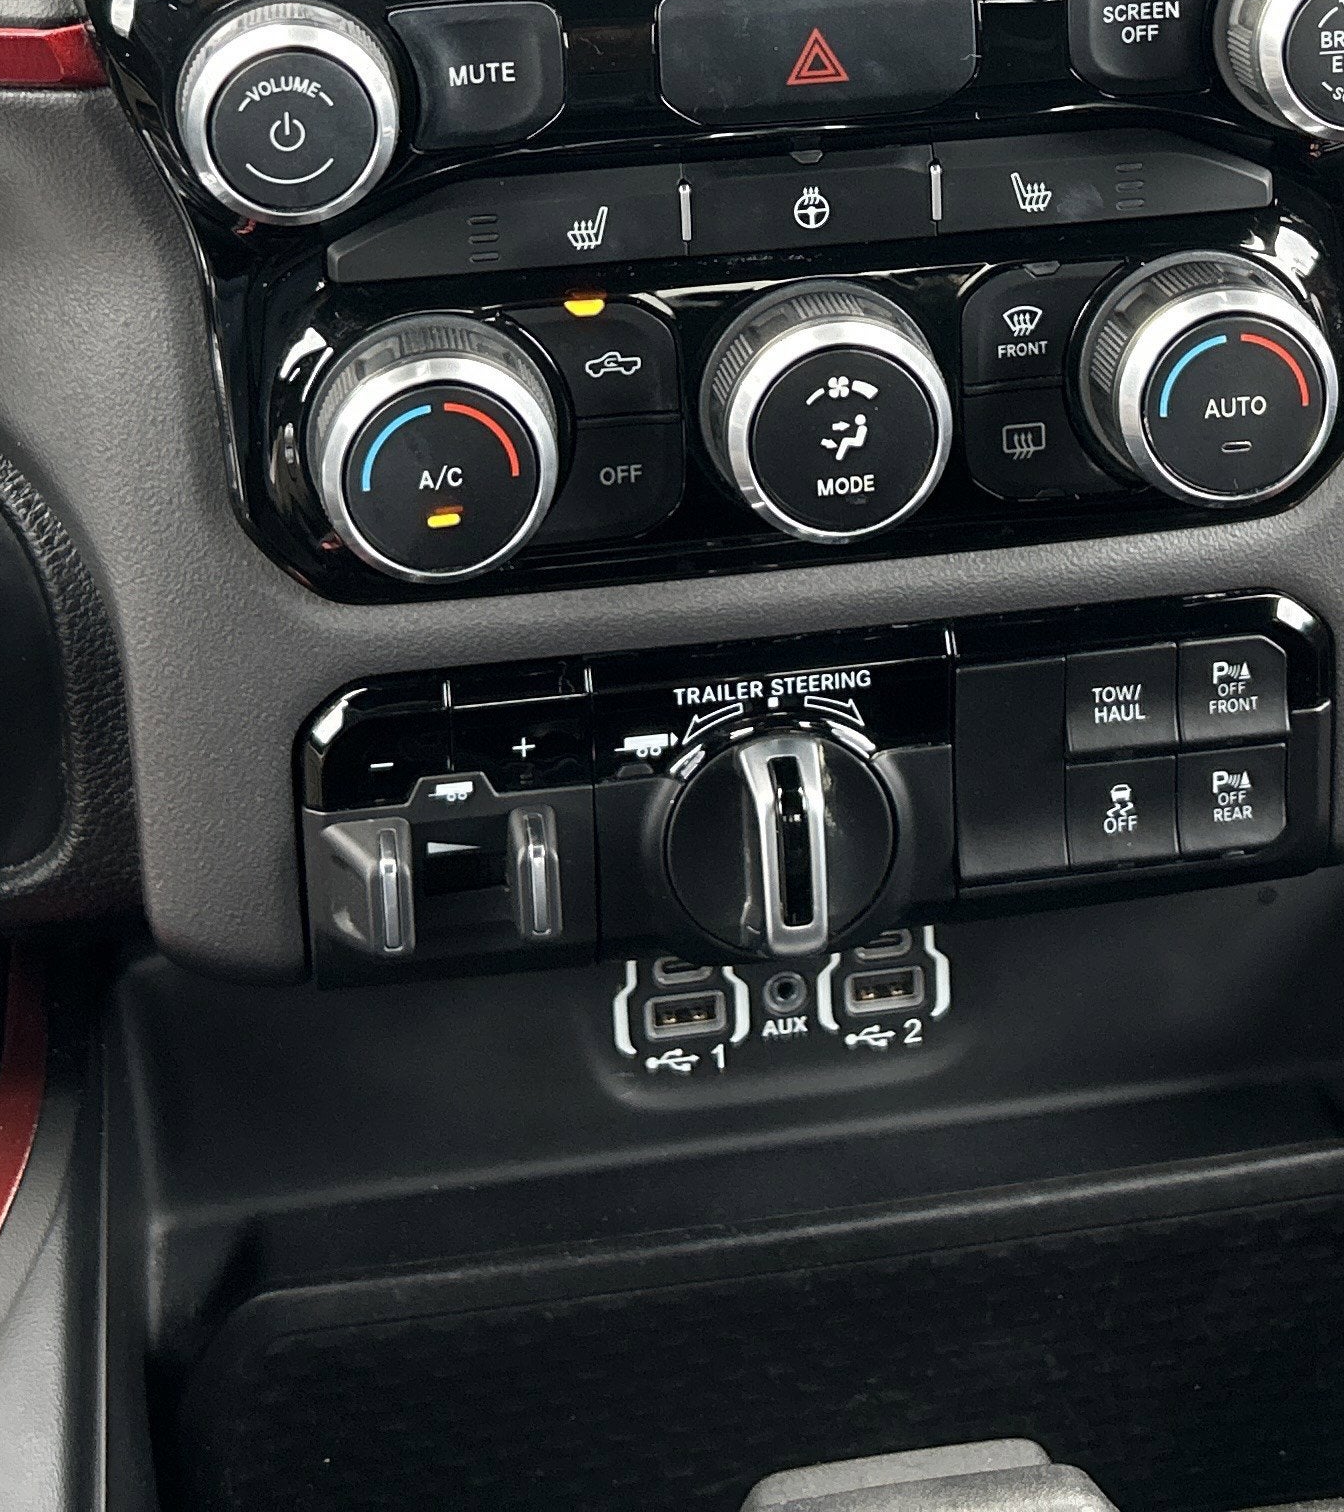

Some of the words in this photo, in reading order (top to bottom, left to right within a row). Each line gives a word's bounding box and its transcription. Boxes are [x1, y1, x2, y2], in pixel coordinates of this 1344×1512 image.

[1103, 1, 1180, 23] SCREEN
[1121, 24, 1159, 44] OFF
[449, 62, 516, 87] MUTE
[246, 75, 321, 102] VOLUME
[998, 339, 1048, 358] FRONT
[1204, 394, 1267, 420] AUTO
[419, 465, 463, 491] A/C
[599, 463, 643, 486] OFF
[816, 473, 875, 498] MODE
[673, 679, 764, 706] TRAILER
[770, 669, 871, 699] STEERING
[1092, 683, 1142, 704] TOW/
[1217, 681, 1246, 698] OFF
[1094, 704, 1145, 724] HAUL
[1209, 696, 1258, 715] FRONT
[1217, 791, 1246, 807] OFF
[1213, 805, 1253, 822] REAR
[1103, 815, 1137, 834] OFF
[762, 1016, 807, 1037] AUX
[903, 1018, 923, 1044] 2
[710, 1042, 725, 1069] 1
